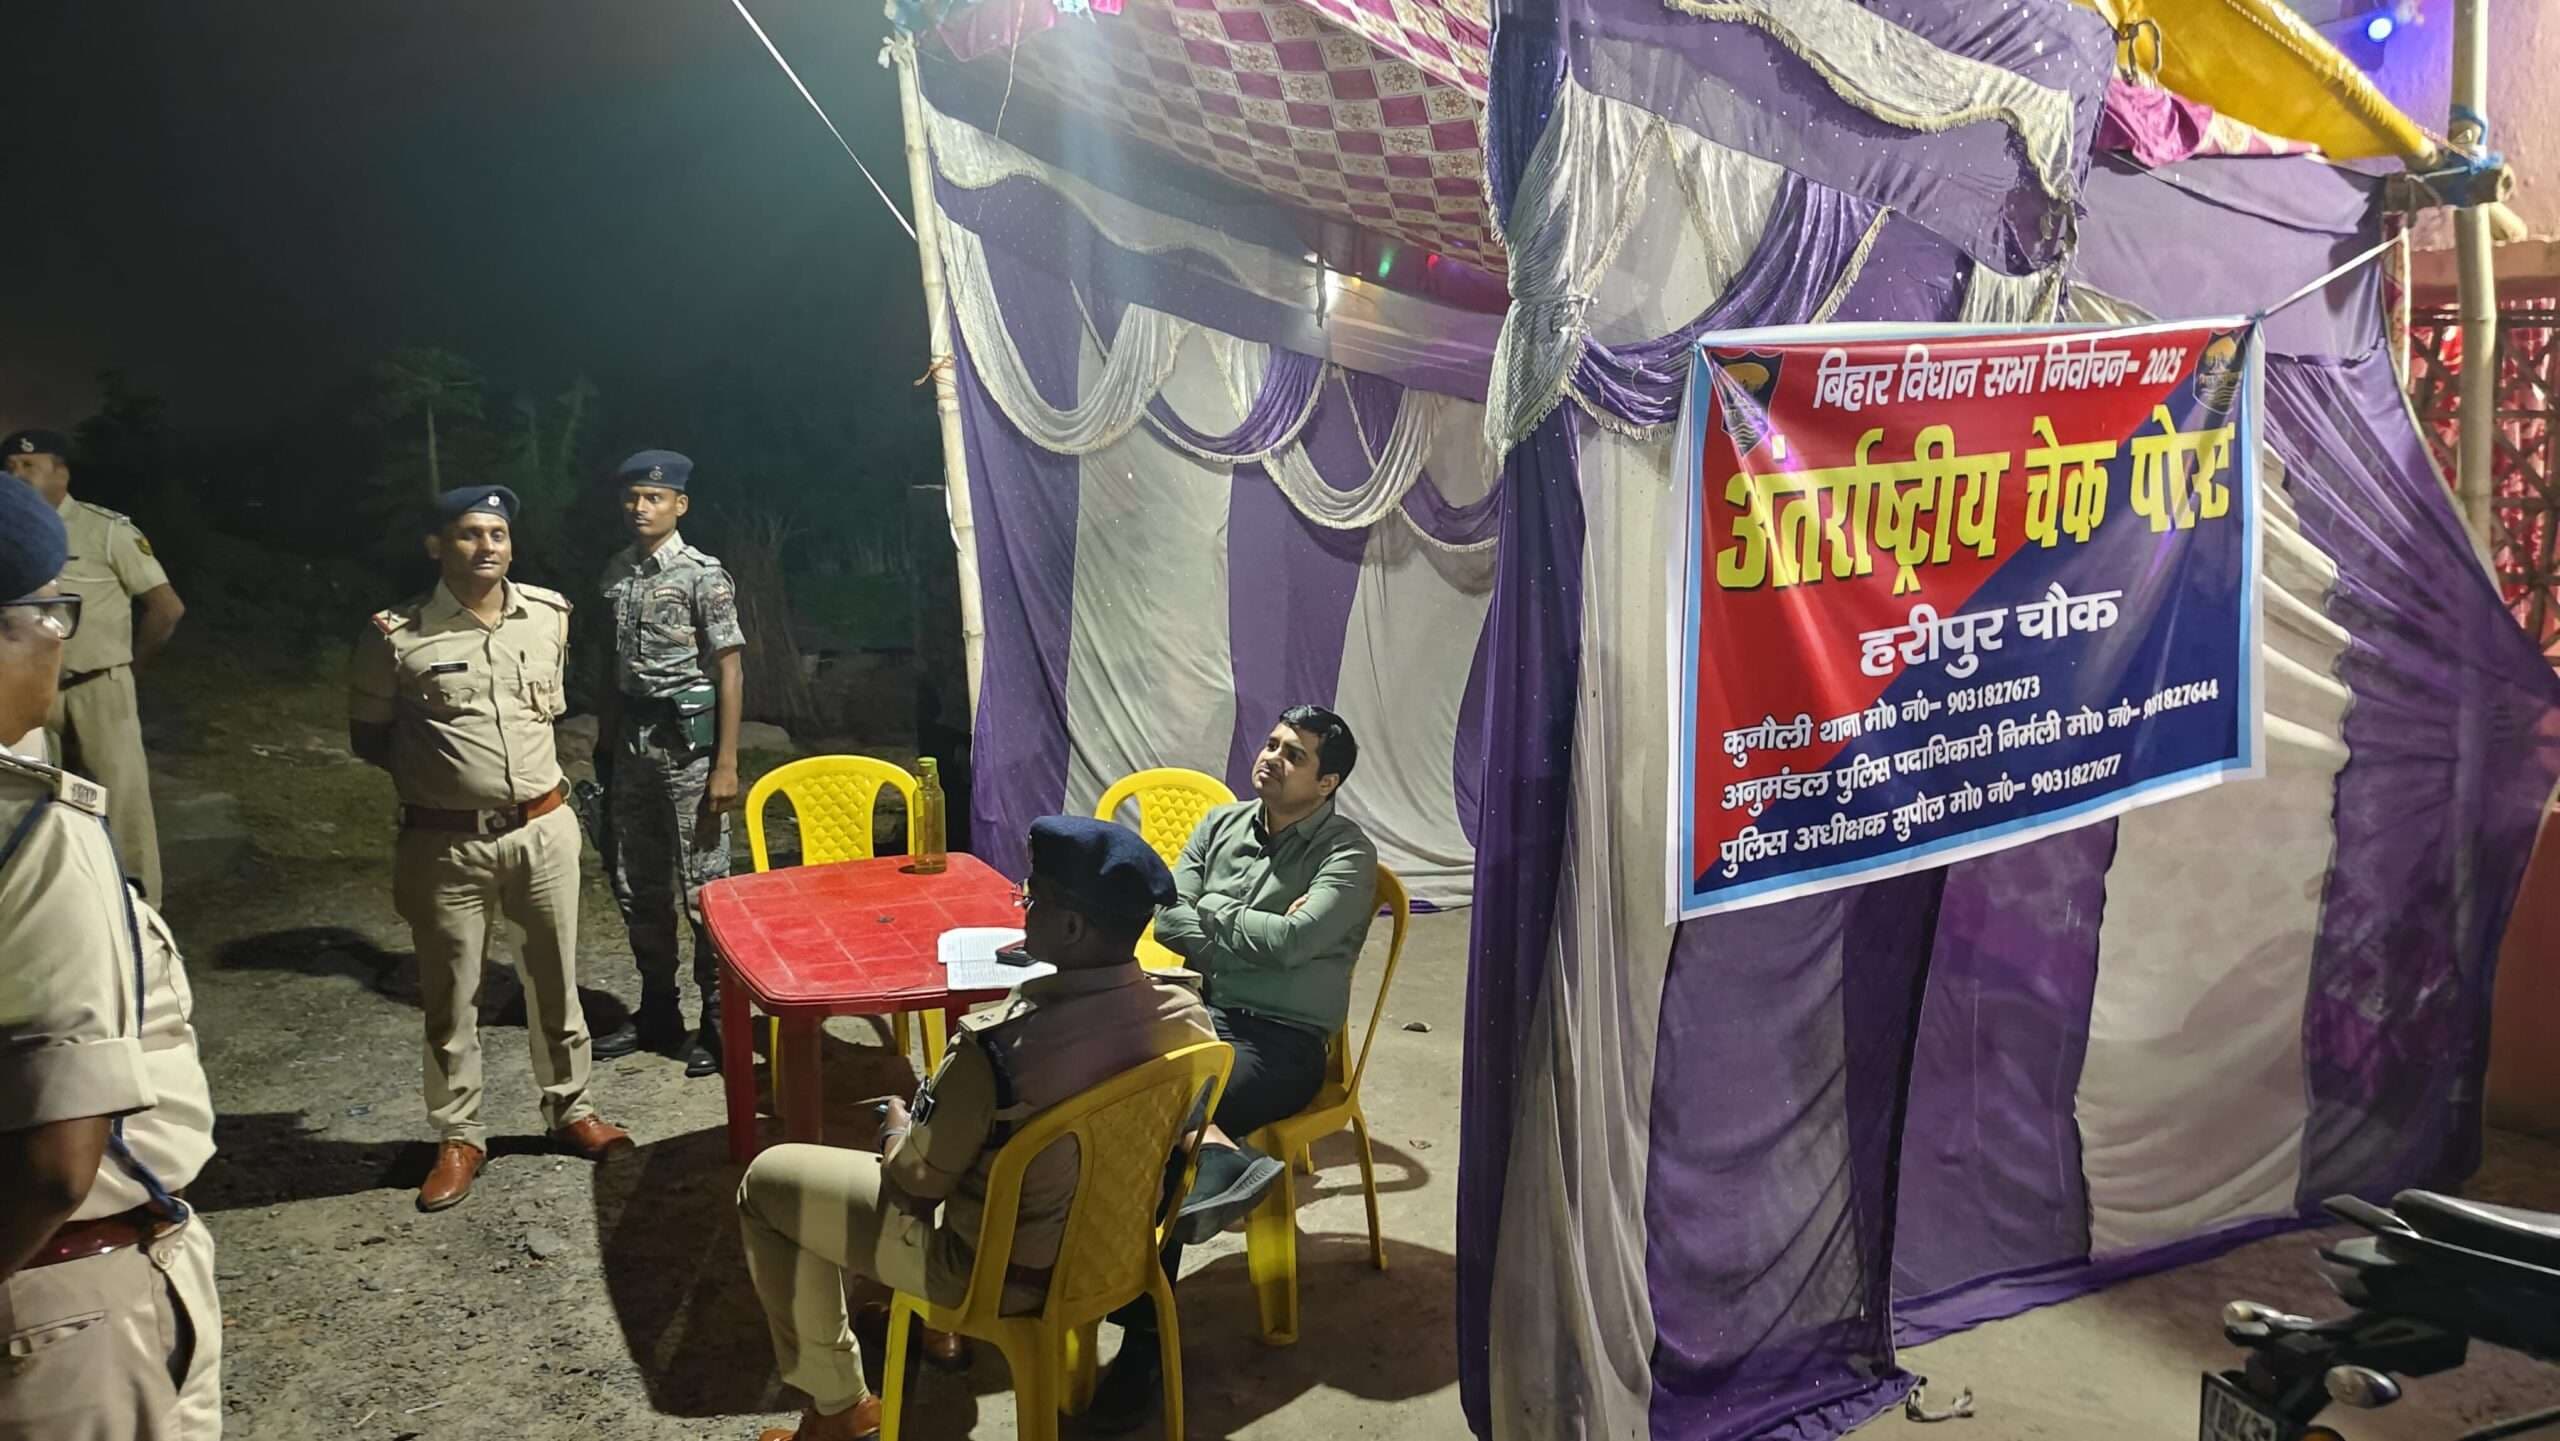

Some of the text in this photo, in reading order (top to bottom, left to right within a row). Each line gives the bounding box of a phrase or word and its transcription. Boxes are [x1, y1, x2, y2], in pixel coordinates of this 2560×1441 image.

[1813, 347, 1897, 411] बिहार
[1898, 343, 1980, 401] विधान
[1984, 355, 2041, 398] सभा
[2140, 346, 2188, 386] 2025
[1716, 404, 2236, 595] अंतर्राष्ट्रीय चेक पोट
[1859, 581, 2122, 678] हरीपुर चौक
[1721, 767, 1832, 816] अनुमंडल
[1836, 753, 1891, 804] पुलिस
[1894, 724, 1993, 775] पदाधिकारी
[1998, 710, 2061, 752] निर्मली
[1723, 713, 1814, 768] कुनौली
[1820, 712, 1861, 743] थाना
[1947, 675, 2040, 716] 9031827673
[1720, 826, 1788, 878] पुलिस
[1794, 813, 1888, 851] अधीक्षक
[1892, 791, 1946, 842] सुपौल
[2031, 753, 2122, 796] 9031827677
